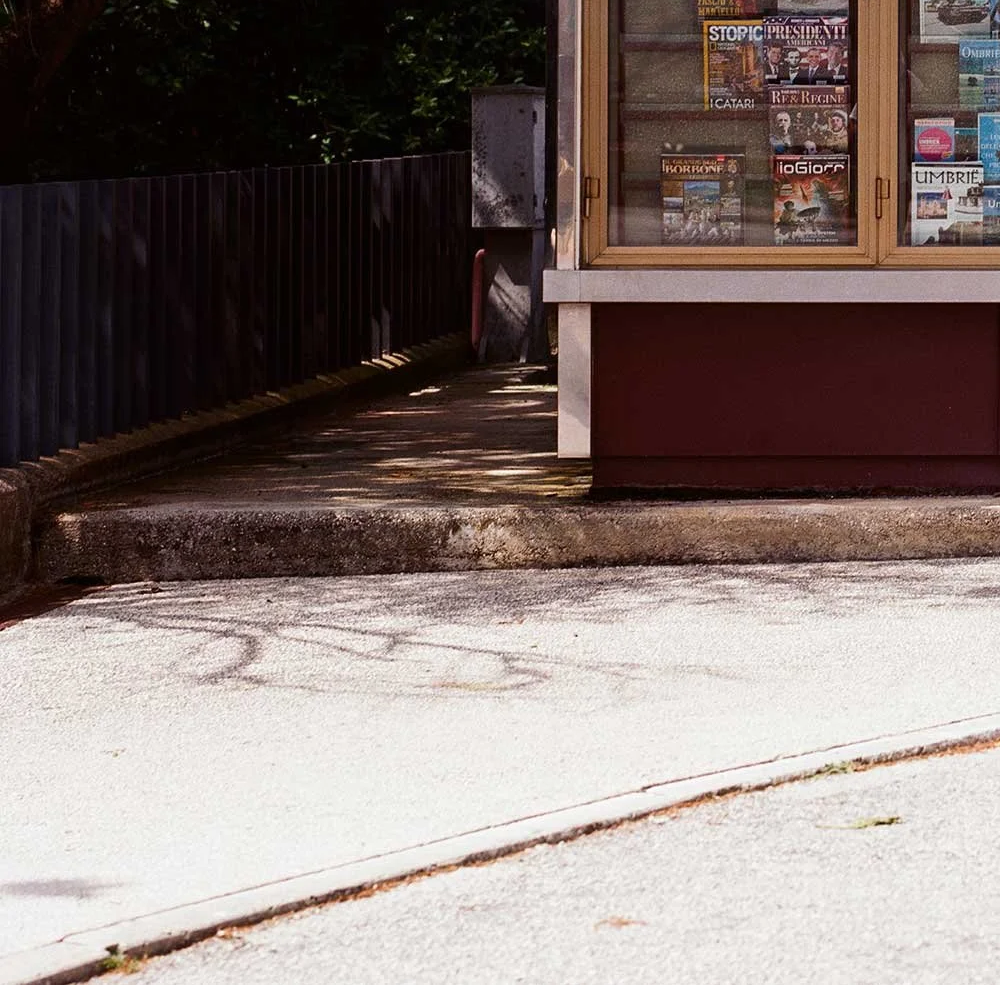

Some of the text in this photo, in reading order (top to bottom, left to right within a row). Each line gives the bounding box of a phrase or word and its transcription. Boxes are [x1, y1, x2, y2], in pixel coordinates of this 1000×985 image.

[709, 26, 763, 41] STORIC
[768, 25, 846, 40] PRESIDENTI
[716, 99, 756, 110] CATARI
[802, 91, 846, 104] REGINE
